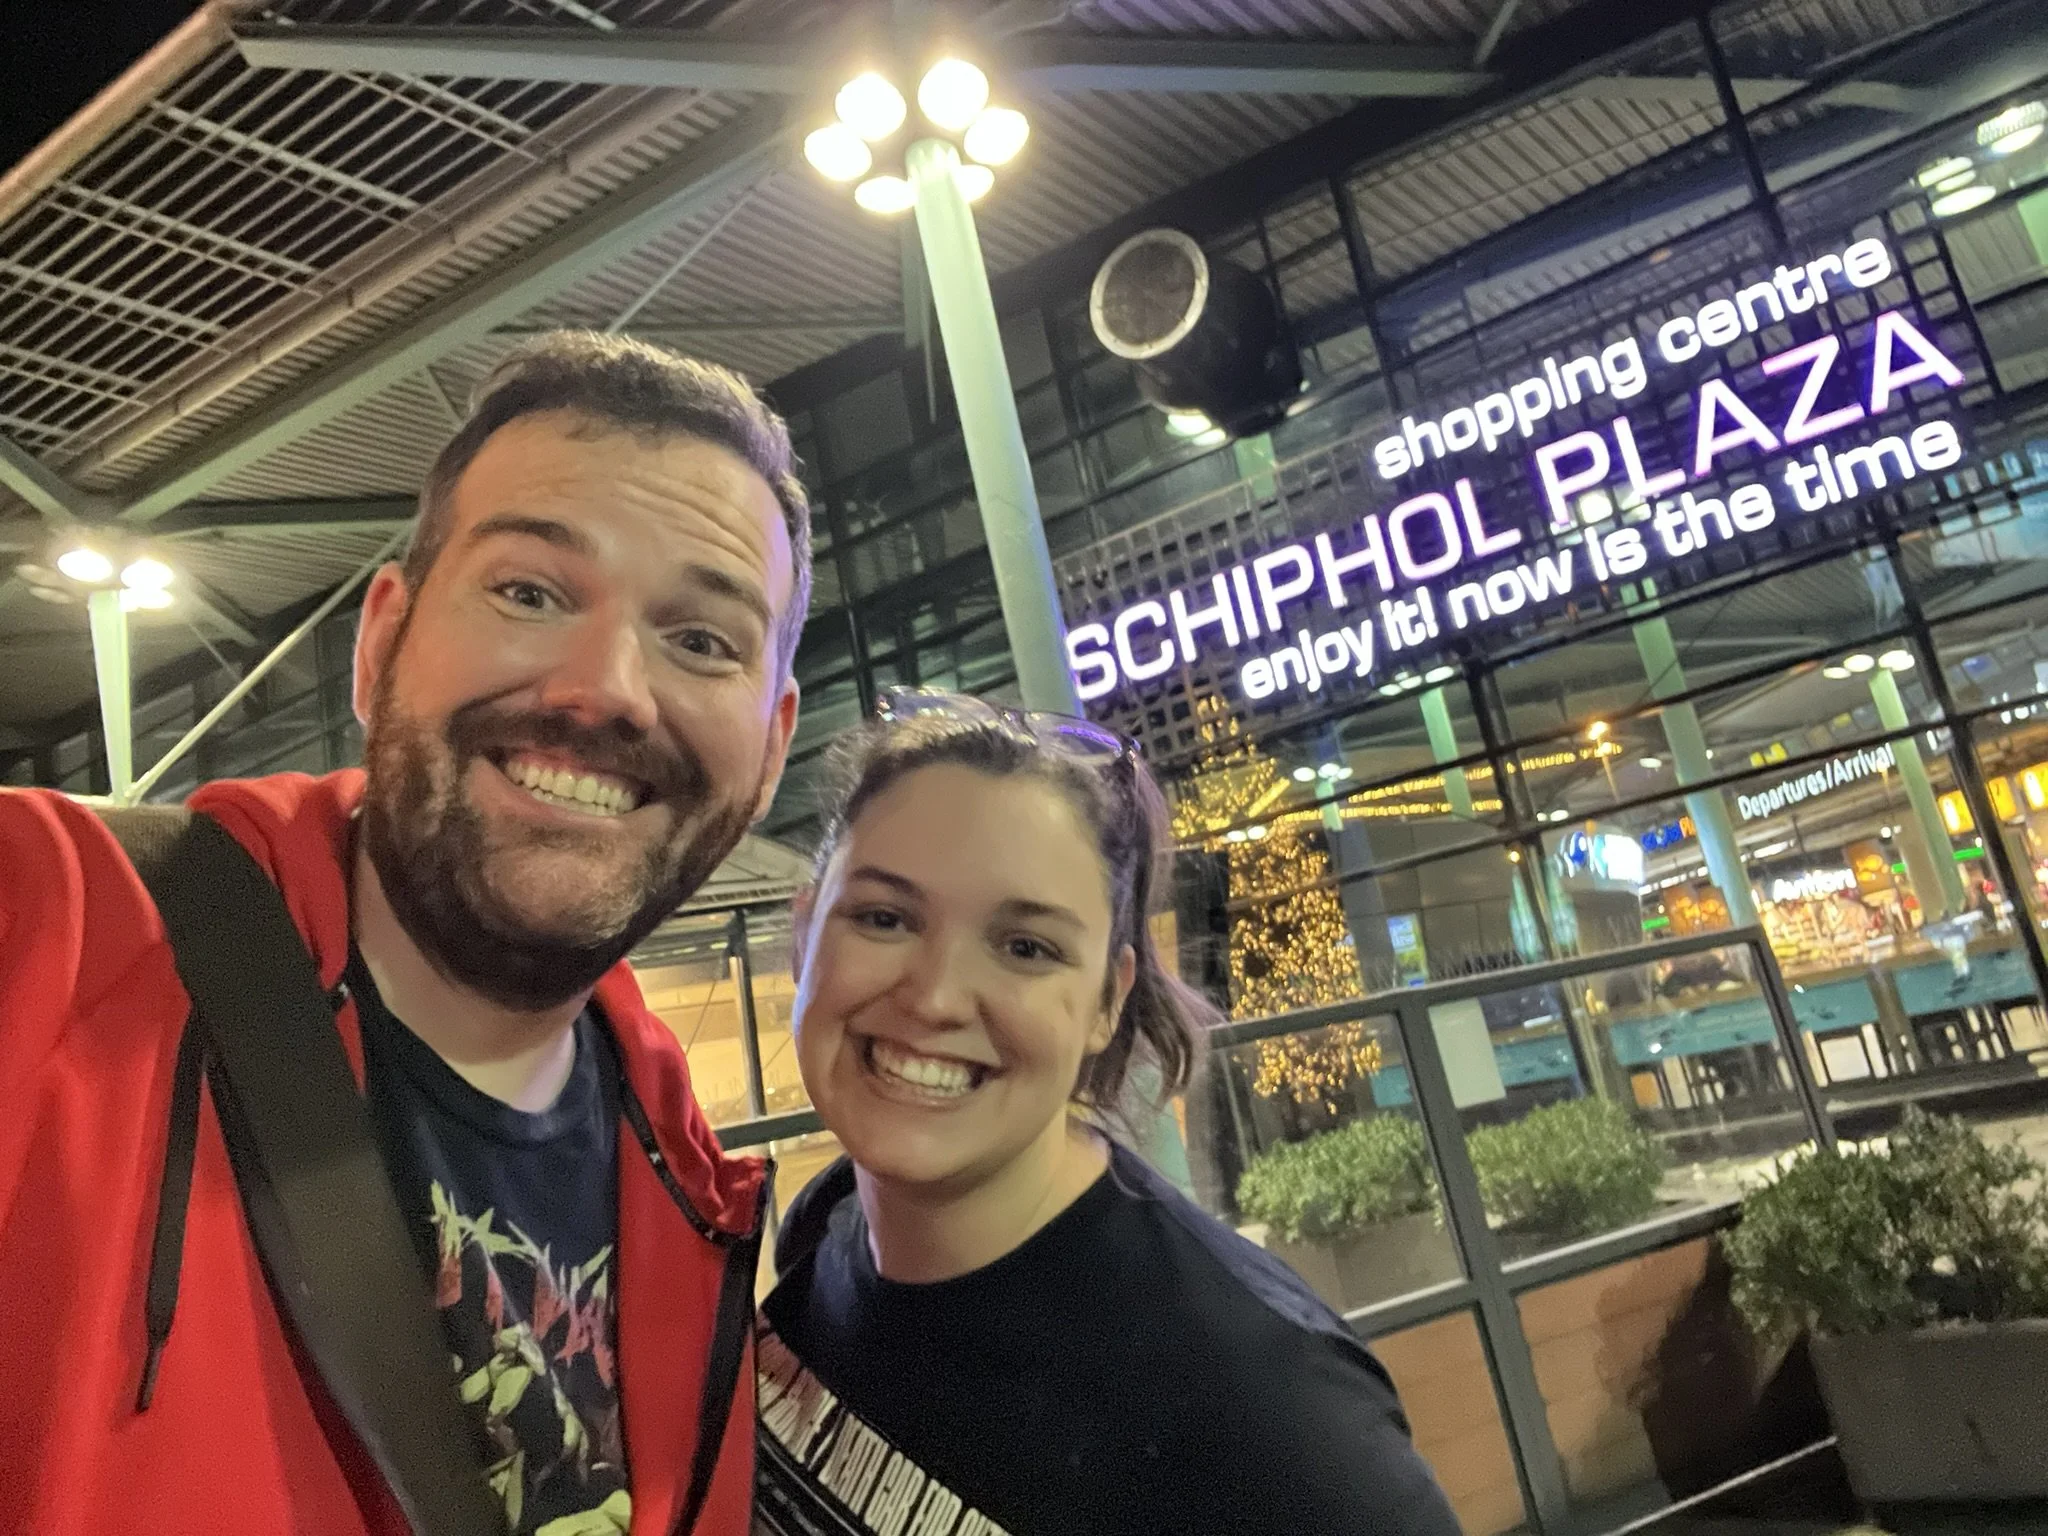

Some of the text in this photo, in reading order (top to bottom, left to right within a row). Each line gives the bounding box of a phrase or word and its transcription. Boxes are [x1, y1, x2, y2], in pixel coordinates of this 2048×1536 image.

[1373, 235, 1893, 481] shopping centre
[1066, 309, 1966, 702] SCHIPHOL PLAZA
[1240, 416, 1963, 700] enjoy it! now is the time
[1737, 742, 1897, 821] Departures/Arrival
